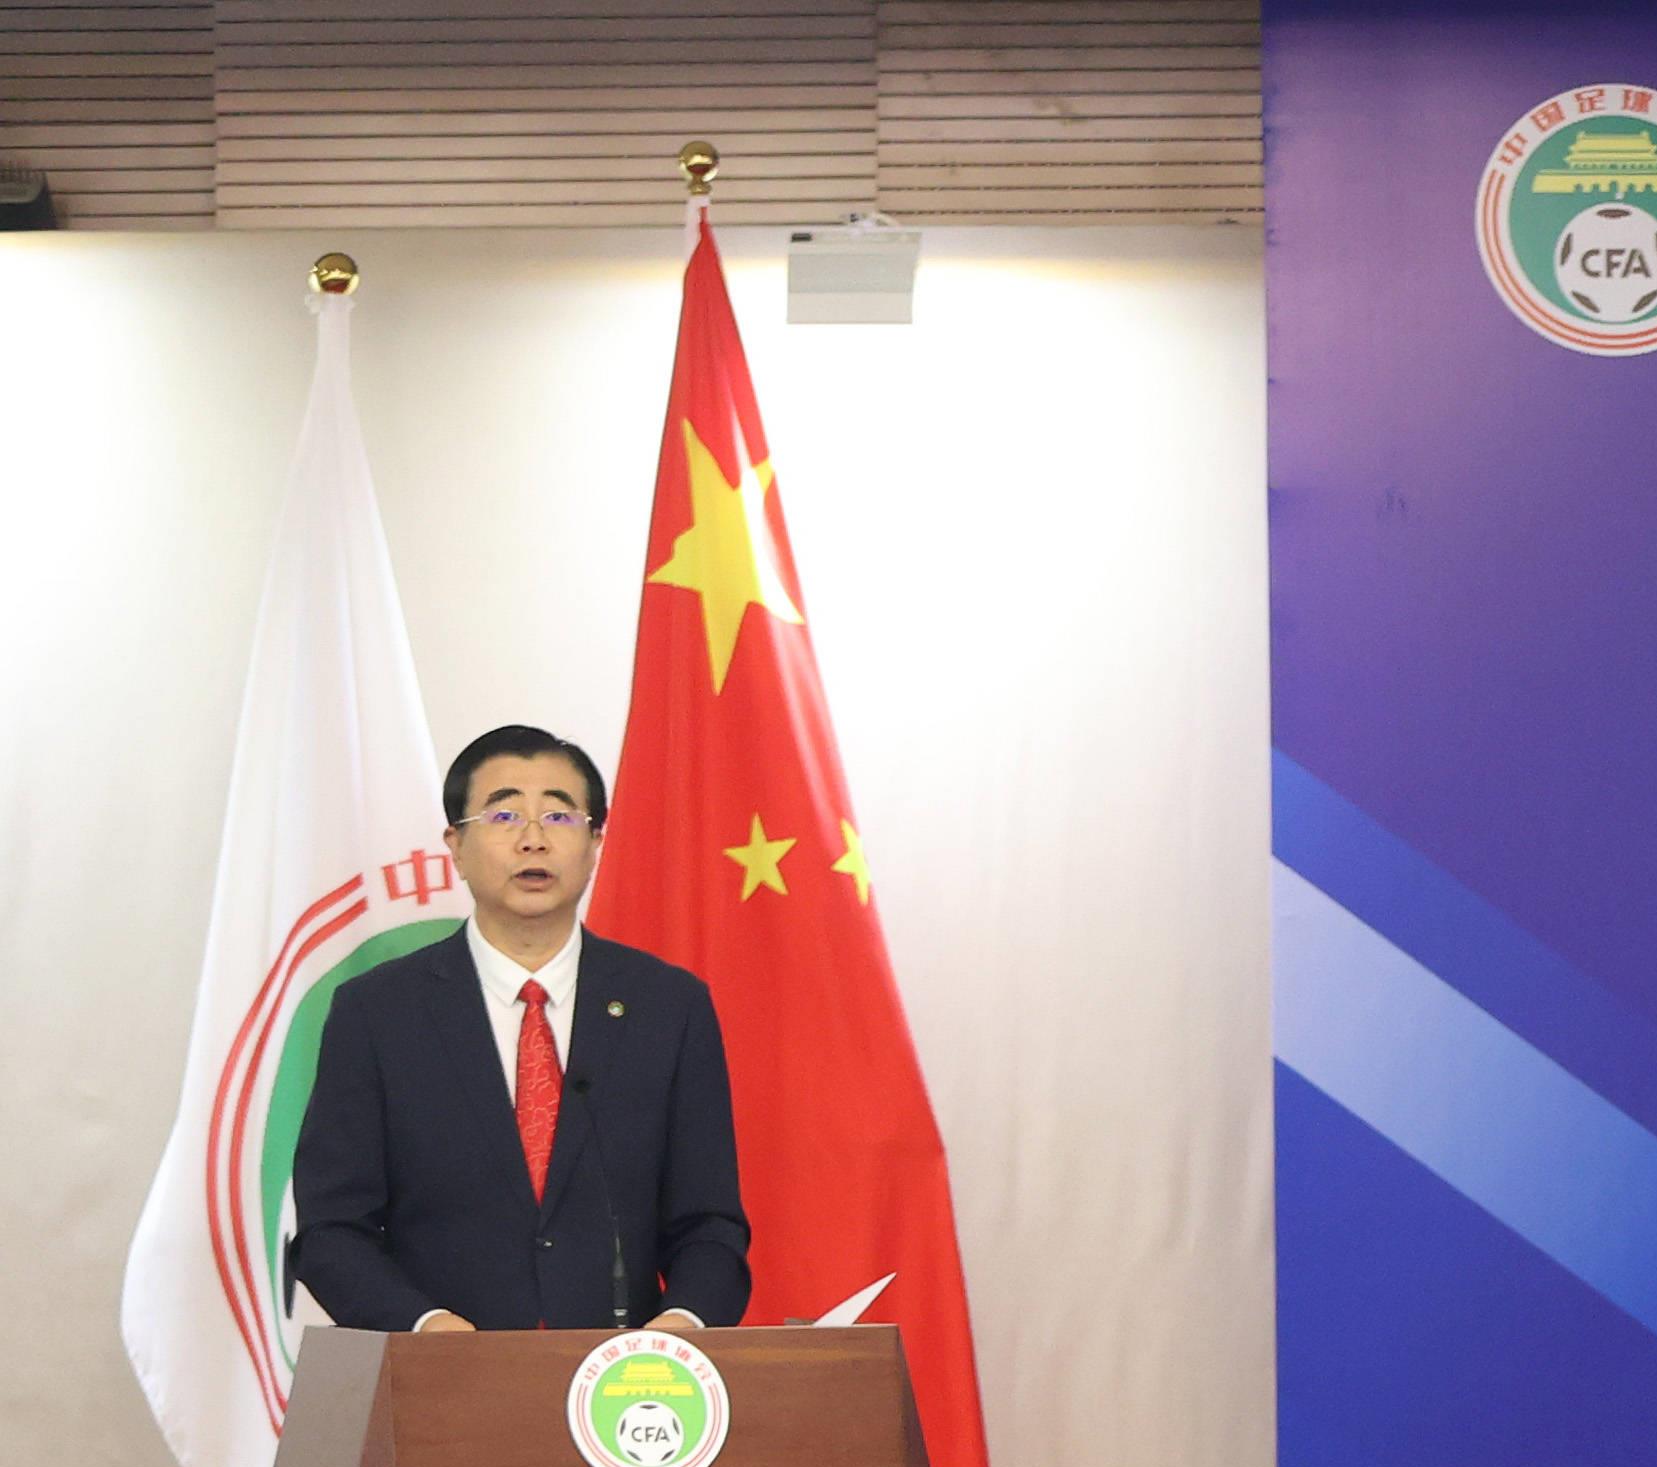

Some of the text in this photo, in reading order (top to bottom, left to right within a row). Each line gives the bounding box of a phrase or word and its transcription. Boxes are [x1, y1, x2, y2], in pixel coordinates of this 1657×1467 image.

[1580, 248, 1651, 279] CFA
[382, 849, 453, 906] 中
[631, 1426, 670, 1443] CFA
